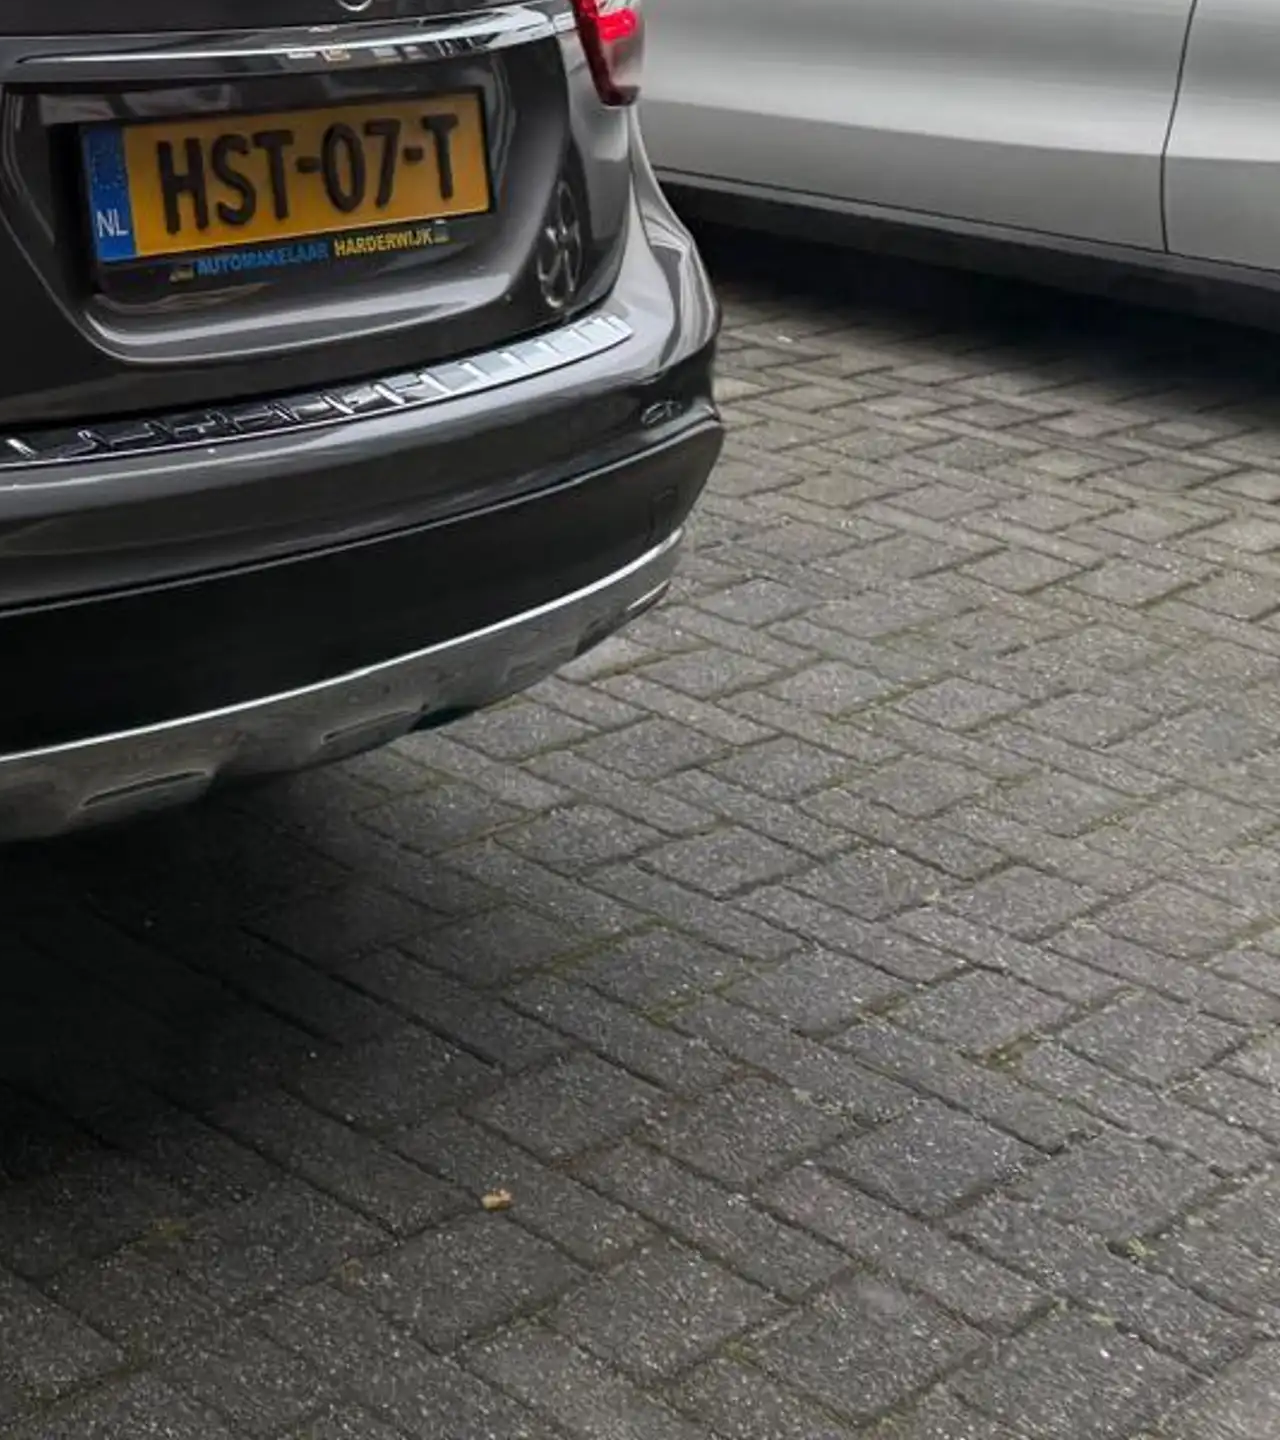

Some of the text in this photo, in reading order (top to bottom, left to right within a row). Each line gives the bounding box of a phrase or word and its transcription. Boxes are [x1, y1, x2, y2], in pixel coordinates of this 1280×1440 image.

[156, 114, 458, 235] HST-07-T
[96, 209, 128, 237] NL
[334, 227, 433, 257] HARDERWIJK
